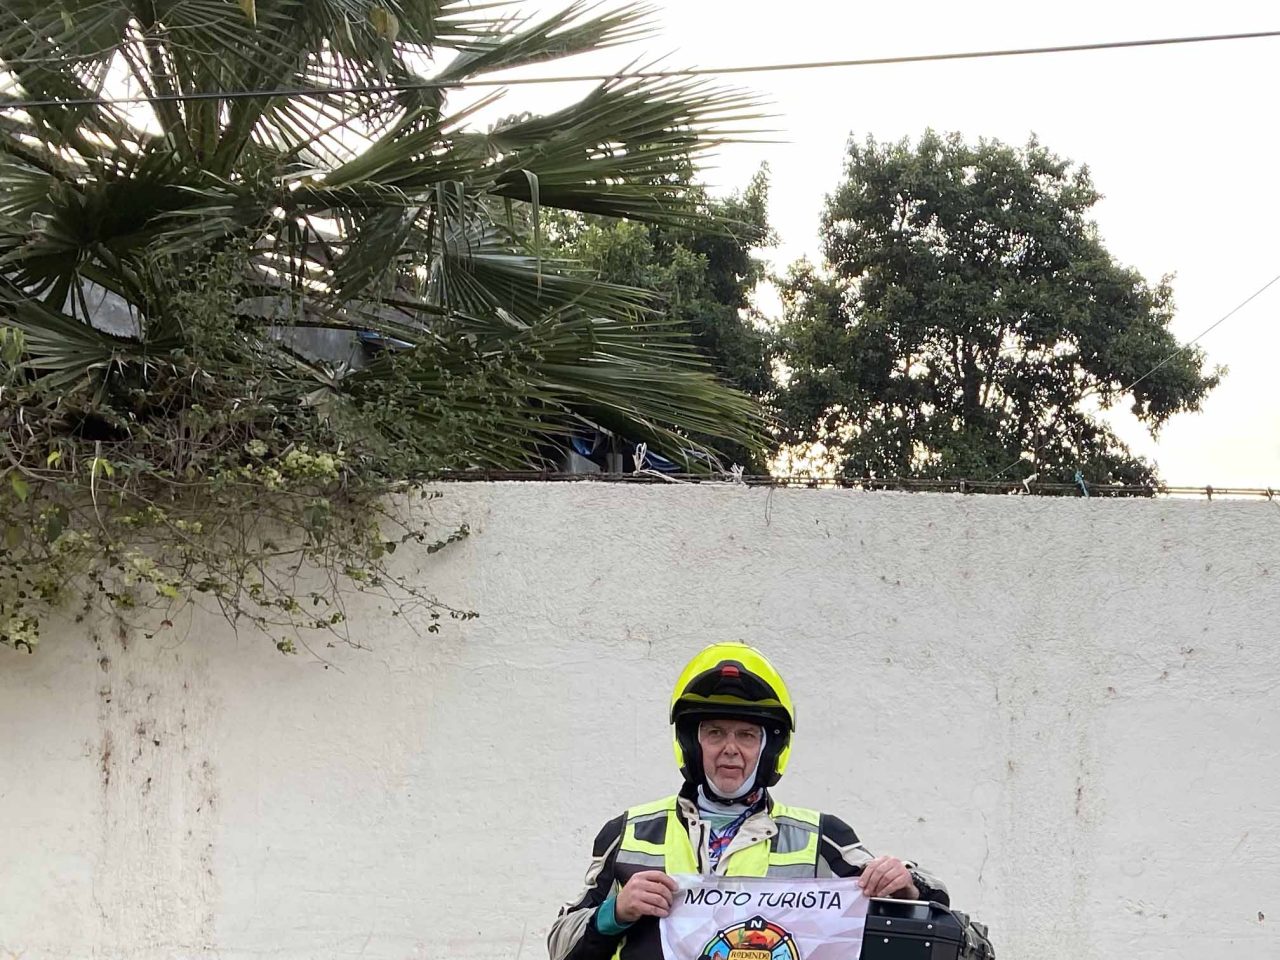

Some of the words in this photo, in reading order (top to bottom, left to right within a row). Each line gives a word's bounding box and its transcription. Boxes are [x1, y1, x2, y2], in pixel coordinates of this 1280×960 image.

[684, 888, 752, 906] MOTO
[757, 891, 842, 910] TURISTA
[751, 920, 762, 928] N
